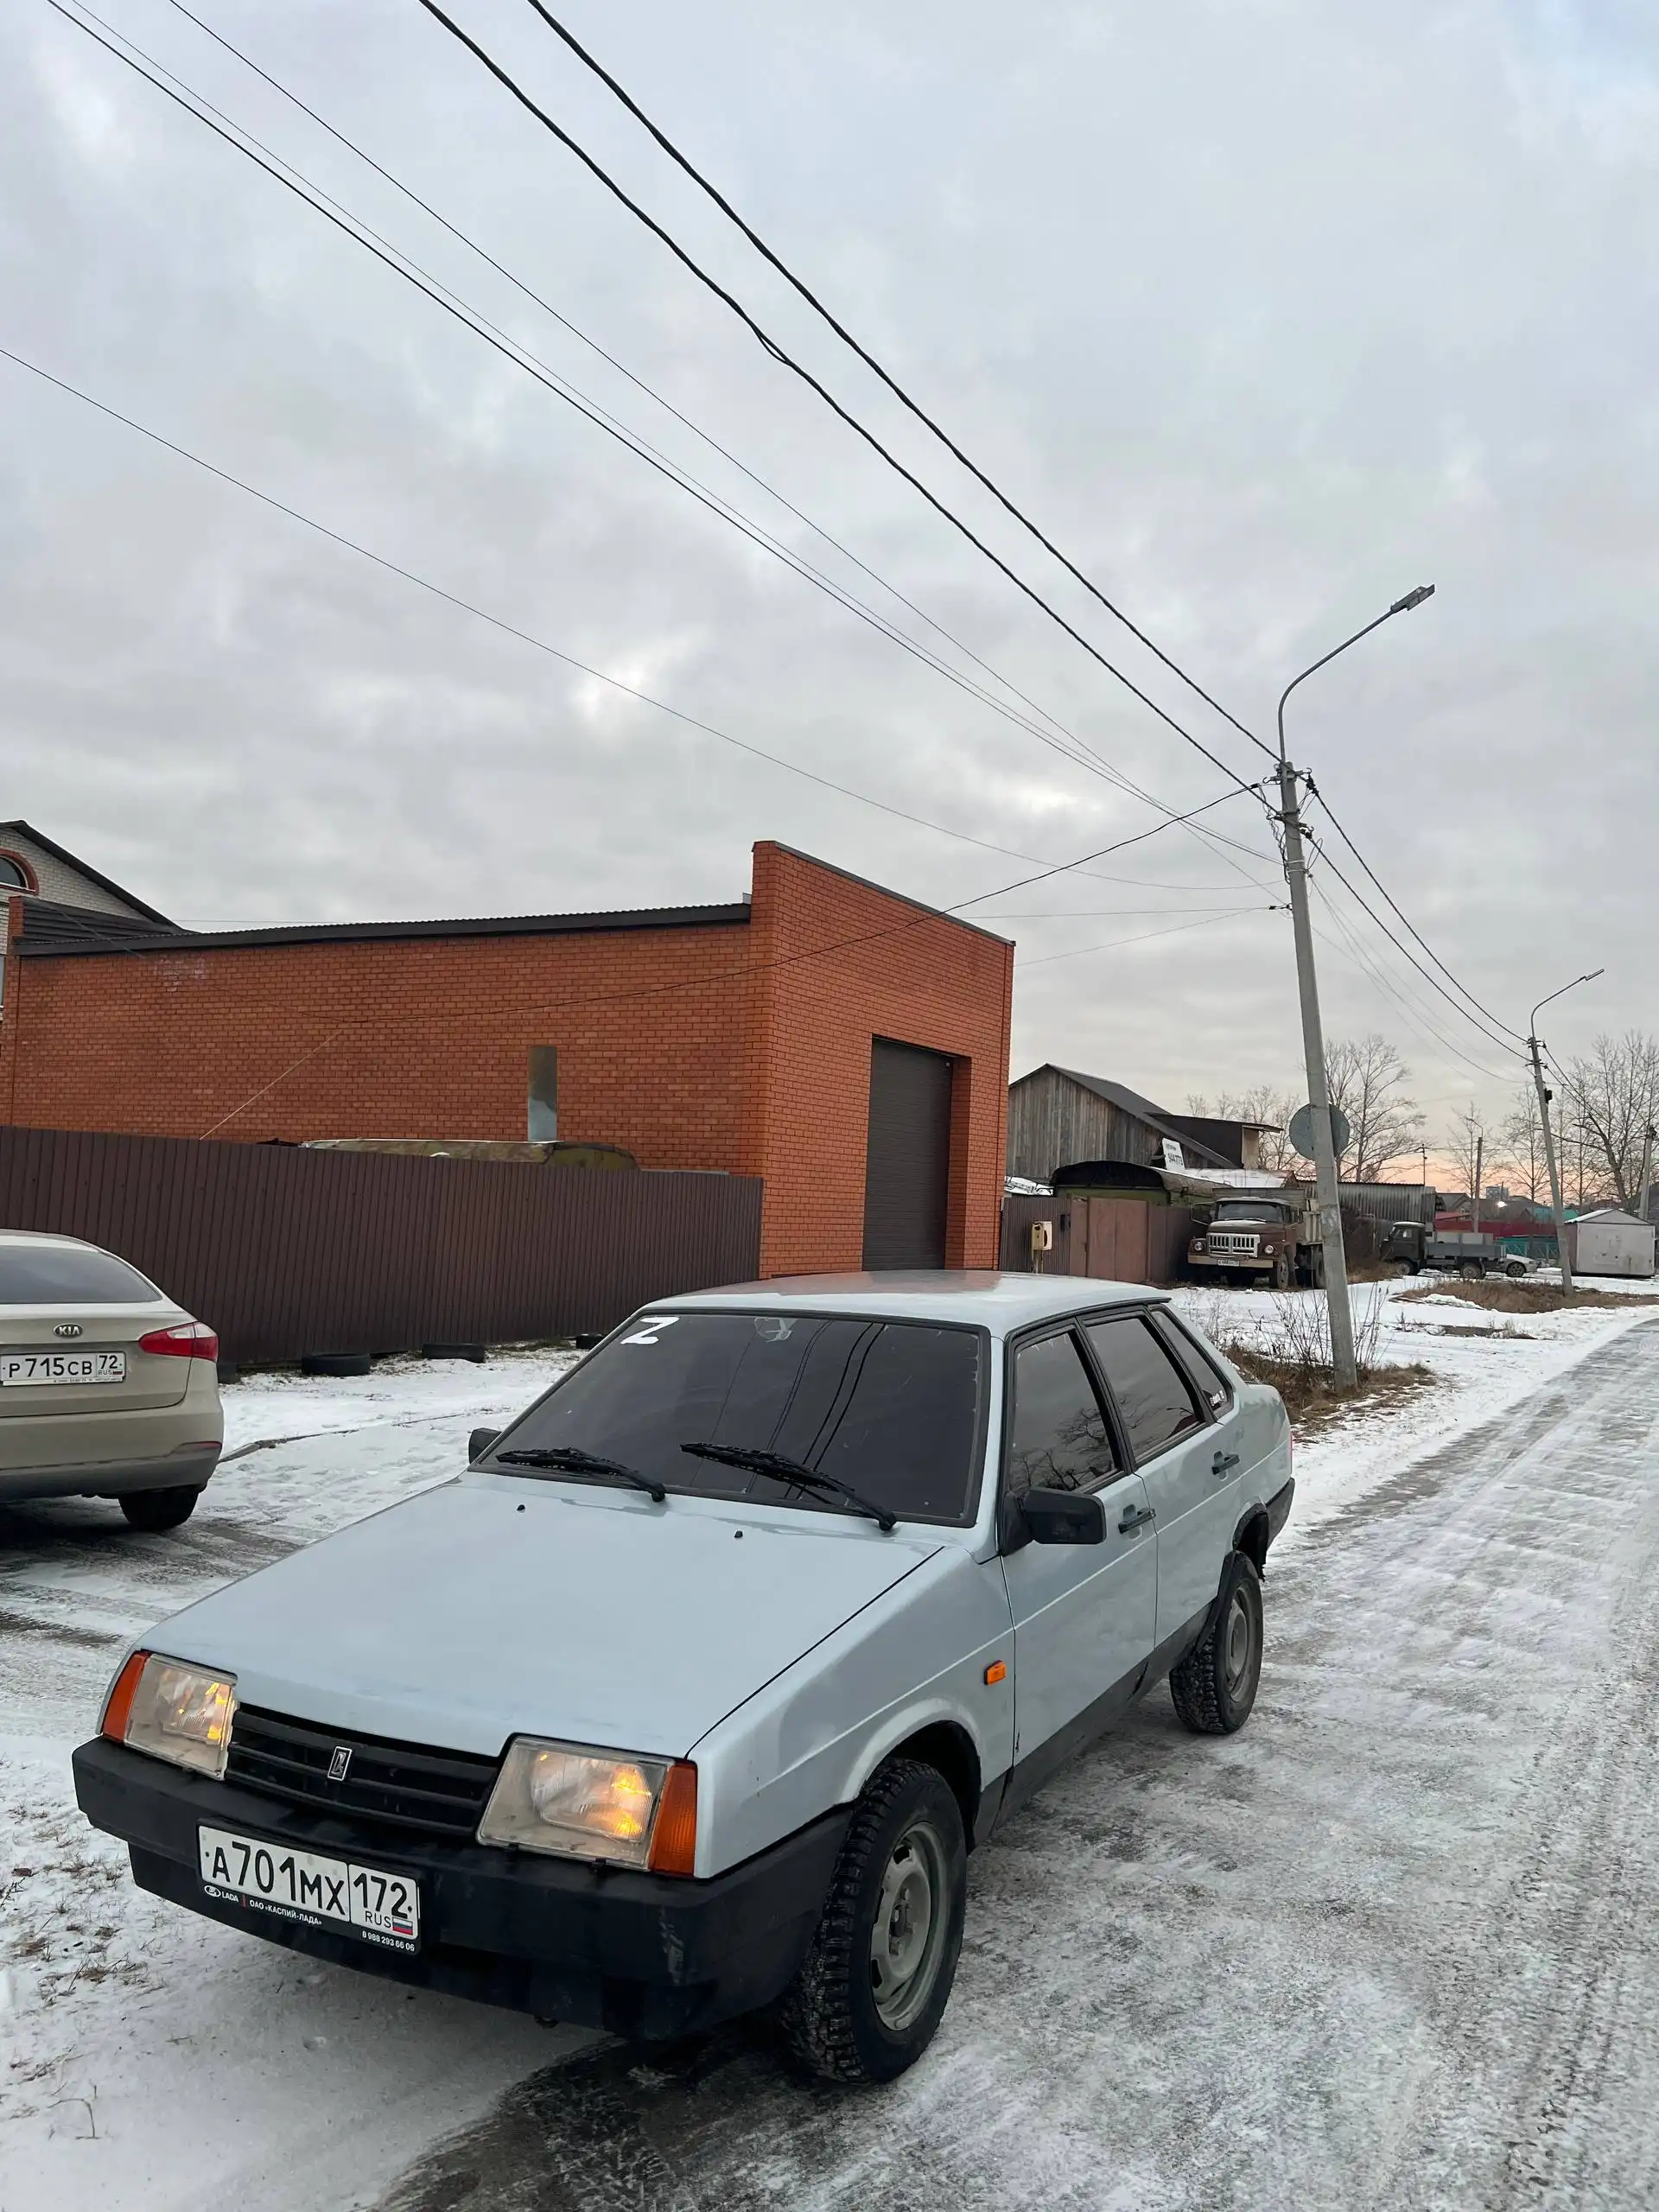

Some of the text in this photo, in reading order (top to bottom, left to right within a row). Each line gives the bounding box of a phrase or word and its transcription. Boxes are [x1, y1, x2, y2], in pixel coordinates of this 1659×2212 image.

[59, 1326, 80, 1335] KIA
[99, 1356, 118, 1369] 72
[221, 1890, 238, 1903] LADA
[353, 1873, 408, 1919] 172
[249, 1899, 264, 1910] ОАО
[365, 1910, 391, 1928] RUS
